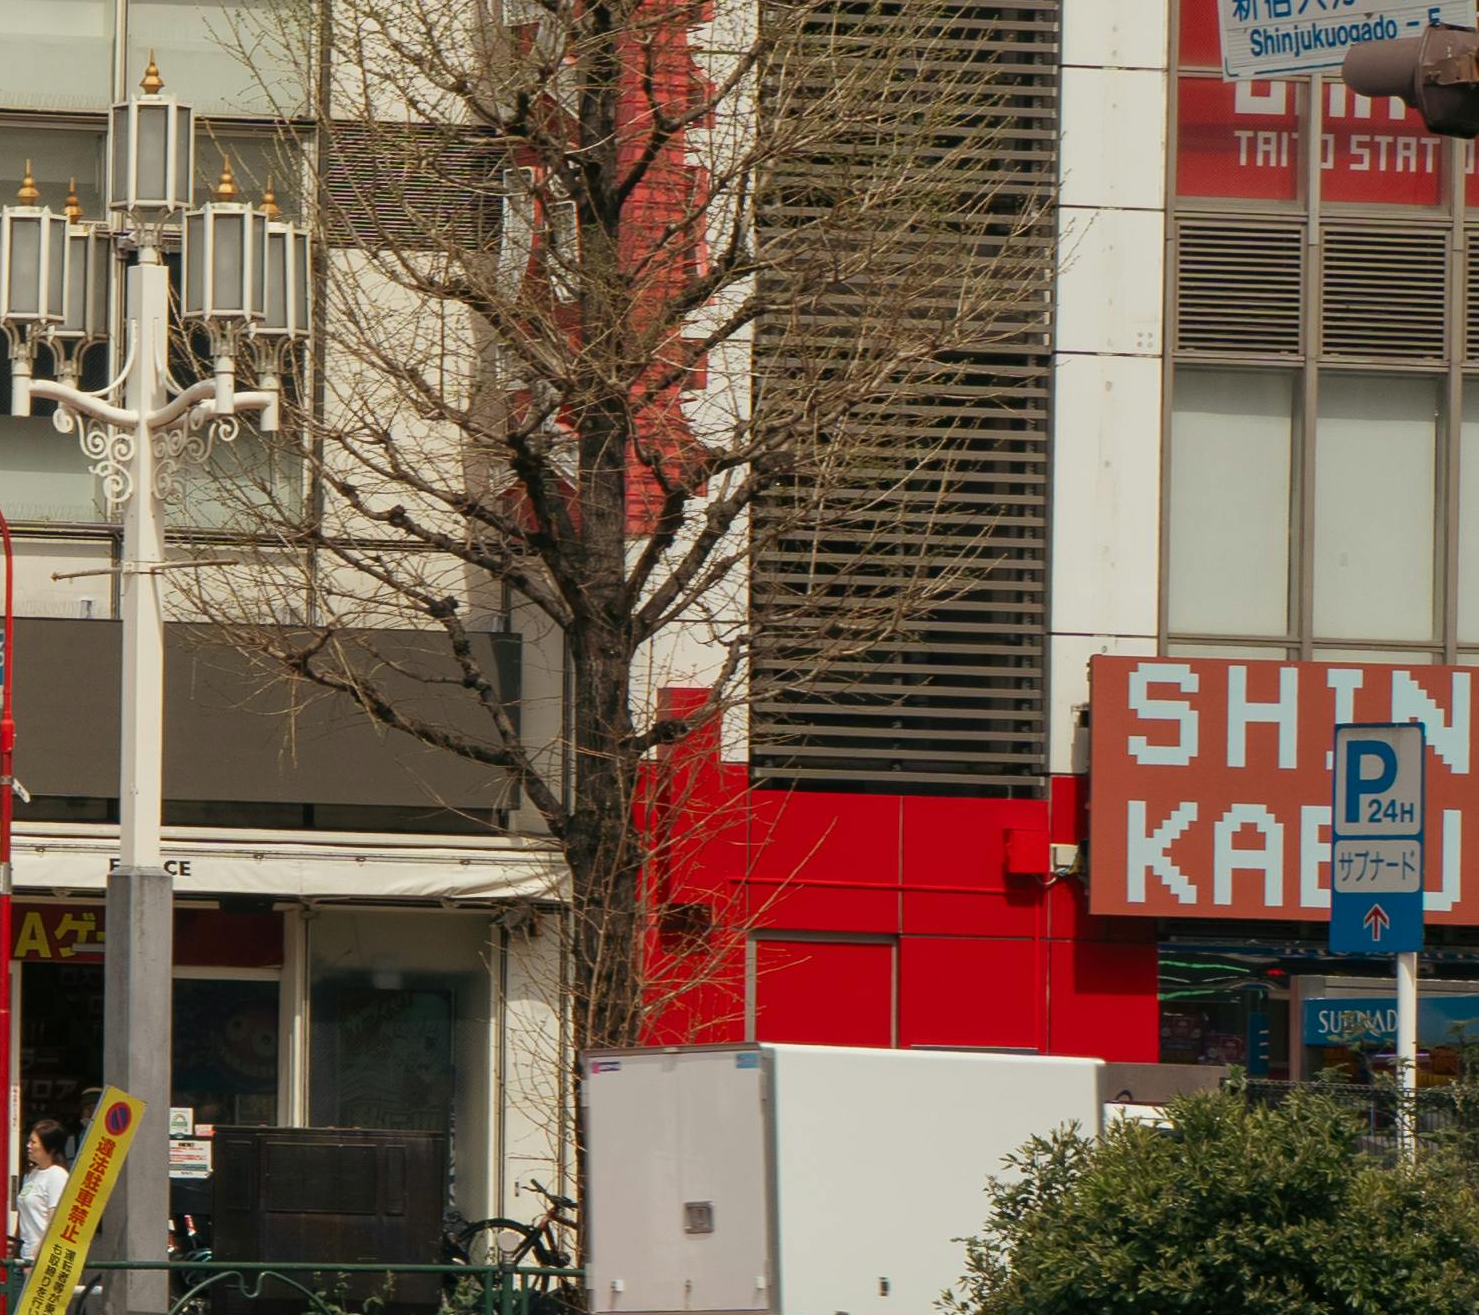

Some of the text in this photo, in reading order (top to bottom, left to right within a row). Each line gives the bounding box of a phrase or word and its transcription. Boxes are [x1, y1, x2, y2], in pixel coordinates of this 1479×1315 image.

[1128, 663, 1470, 774] SHIN
[1344, 739, 1398, 824] P
[1366, 798, 1415, 825] 24H
[109, 858, 192, 876] ECE
[1338, 846, 1418, 884] サブナード
[60, 1137, 116, 1245] 違法駐車禁止
